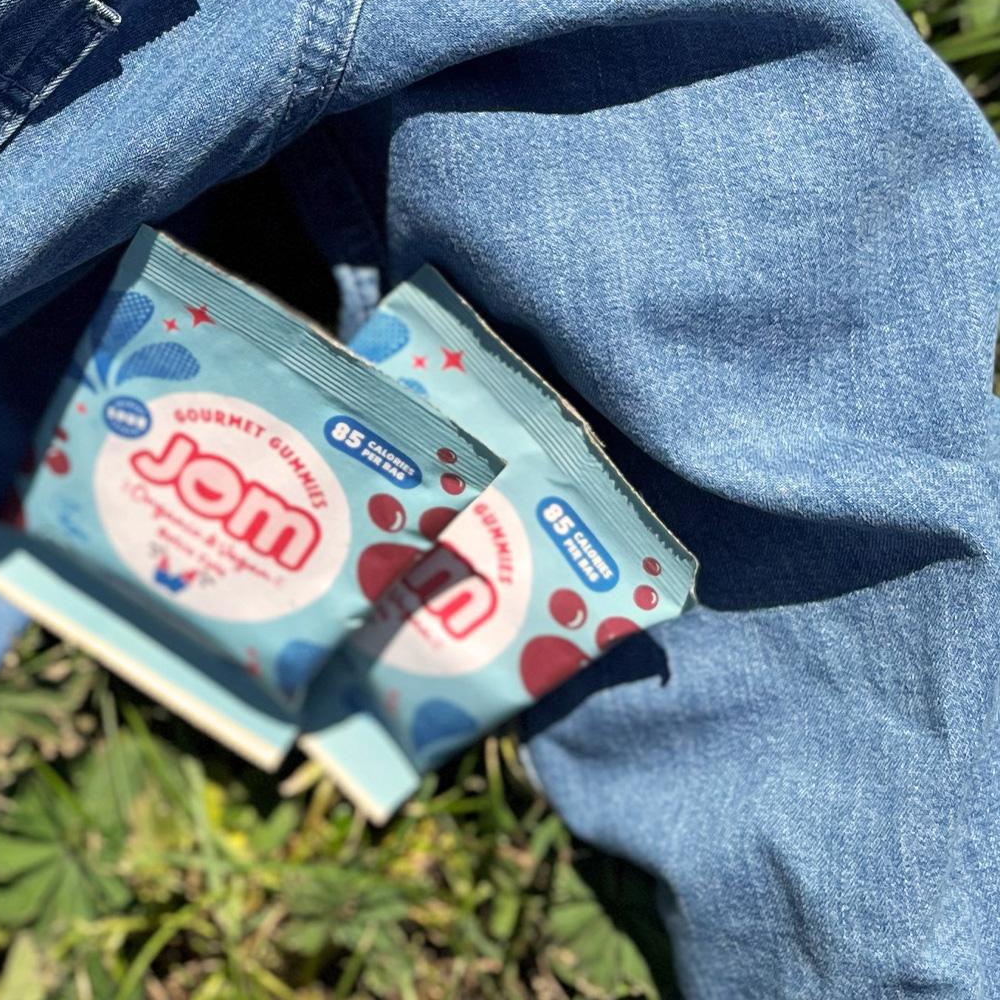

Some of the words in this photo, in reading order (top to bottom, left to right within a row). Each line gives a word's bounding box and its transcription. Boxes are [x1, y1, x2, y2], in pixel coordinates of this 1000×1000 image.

[331, 422, 365, 450] 85
[174, 408, 266, 438] GOURMET
[268, 436, 328, 510] GUMMIES
[361, 448, 382, 466] PER
[382, 461, 405, 481] BAG
[367, 440, 415, 476] CALORIES
[543, 503, 575, 535] 85
[472, 502, 514, 585] GUMMIES
[563, 538, 582, 560] PER
[577, 558, 599, 582] BAG
[574, 531, 614, 580] CALORIES
